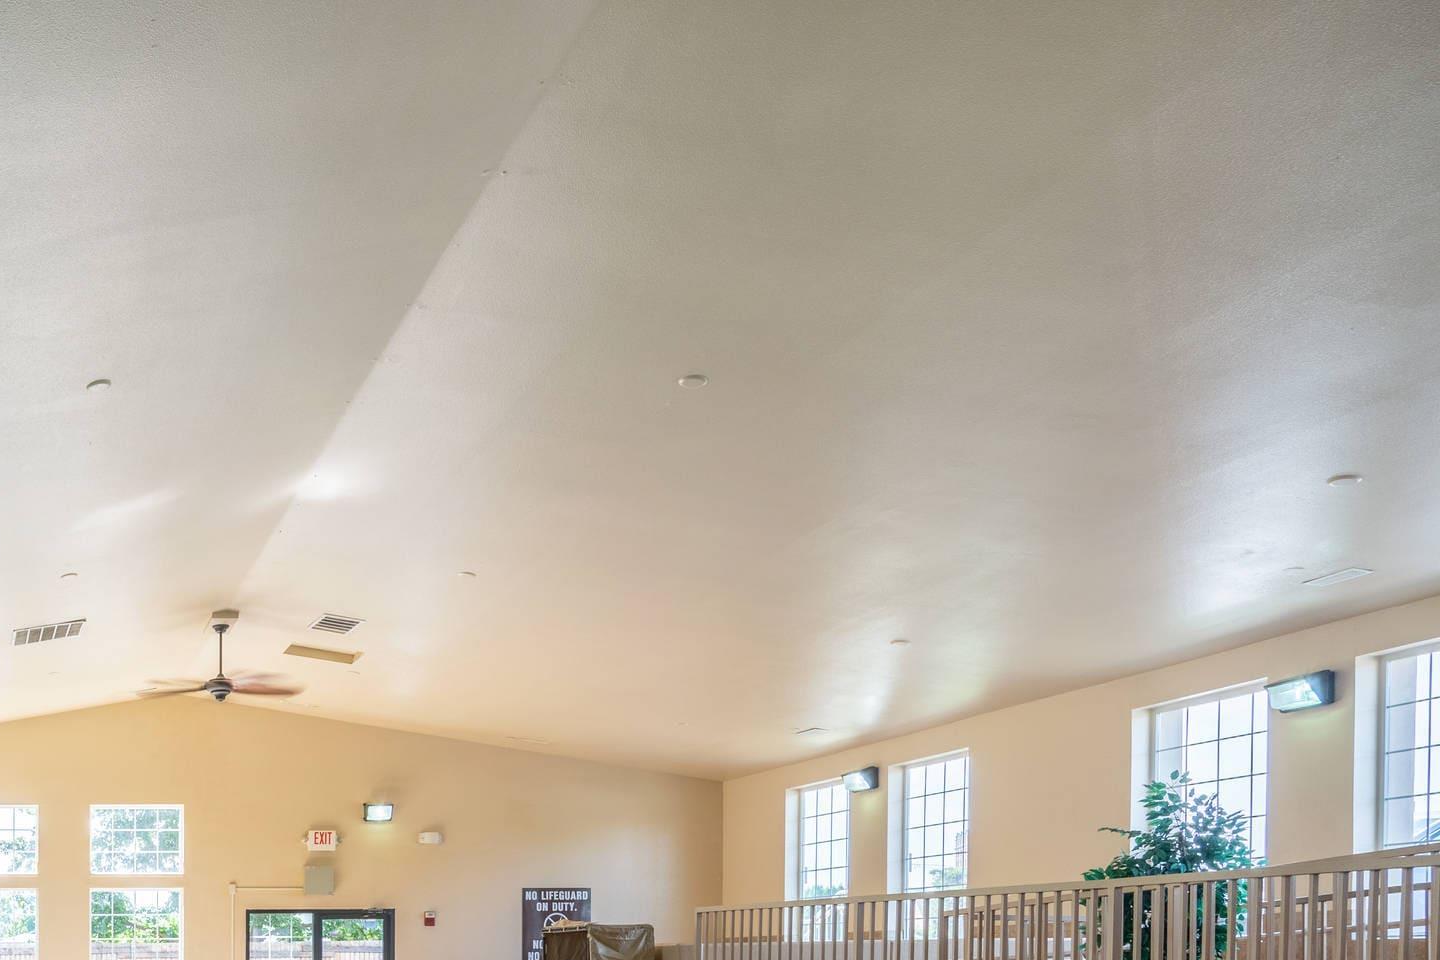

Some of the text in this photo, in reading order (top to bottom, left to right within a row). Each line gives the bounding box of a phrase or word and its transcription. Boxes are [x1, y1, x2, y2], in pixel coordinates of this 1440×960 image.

[314, 831, 332, 845] EXIT
[525, 891, 588, 900] NO LIFEGUARD
[536, 902, 578, 911] ON DUTY.
[528, 952, 540, 960] NO
